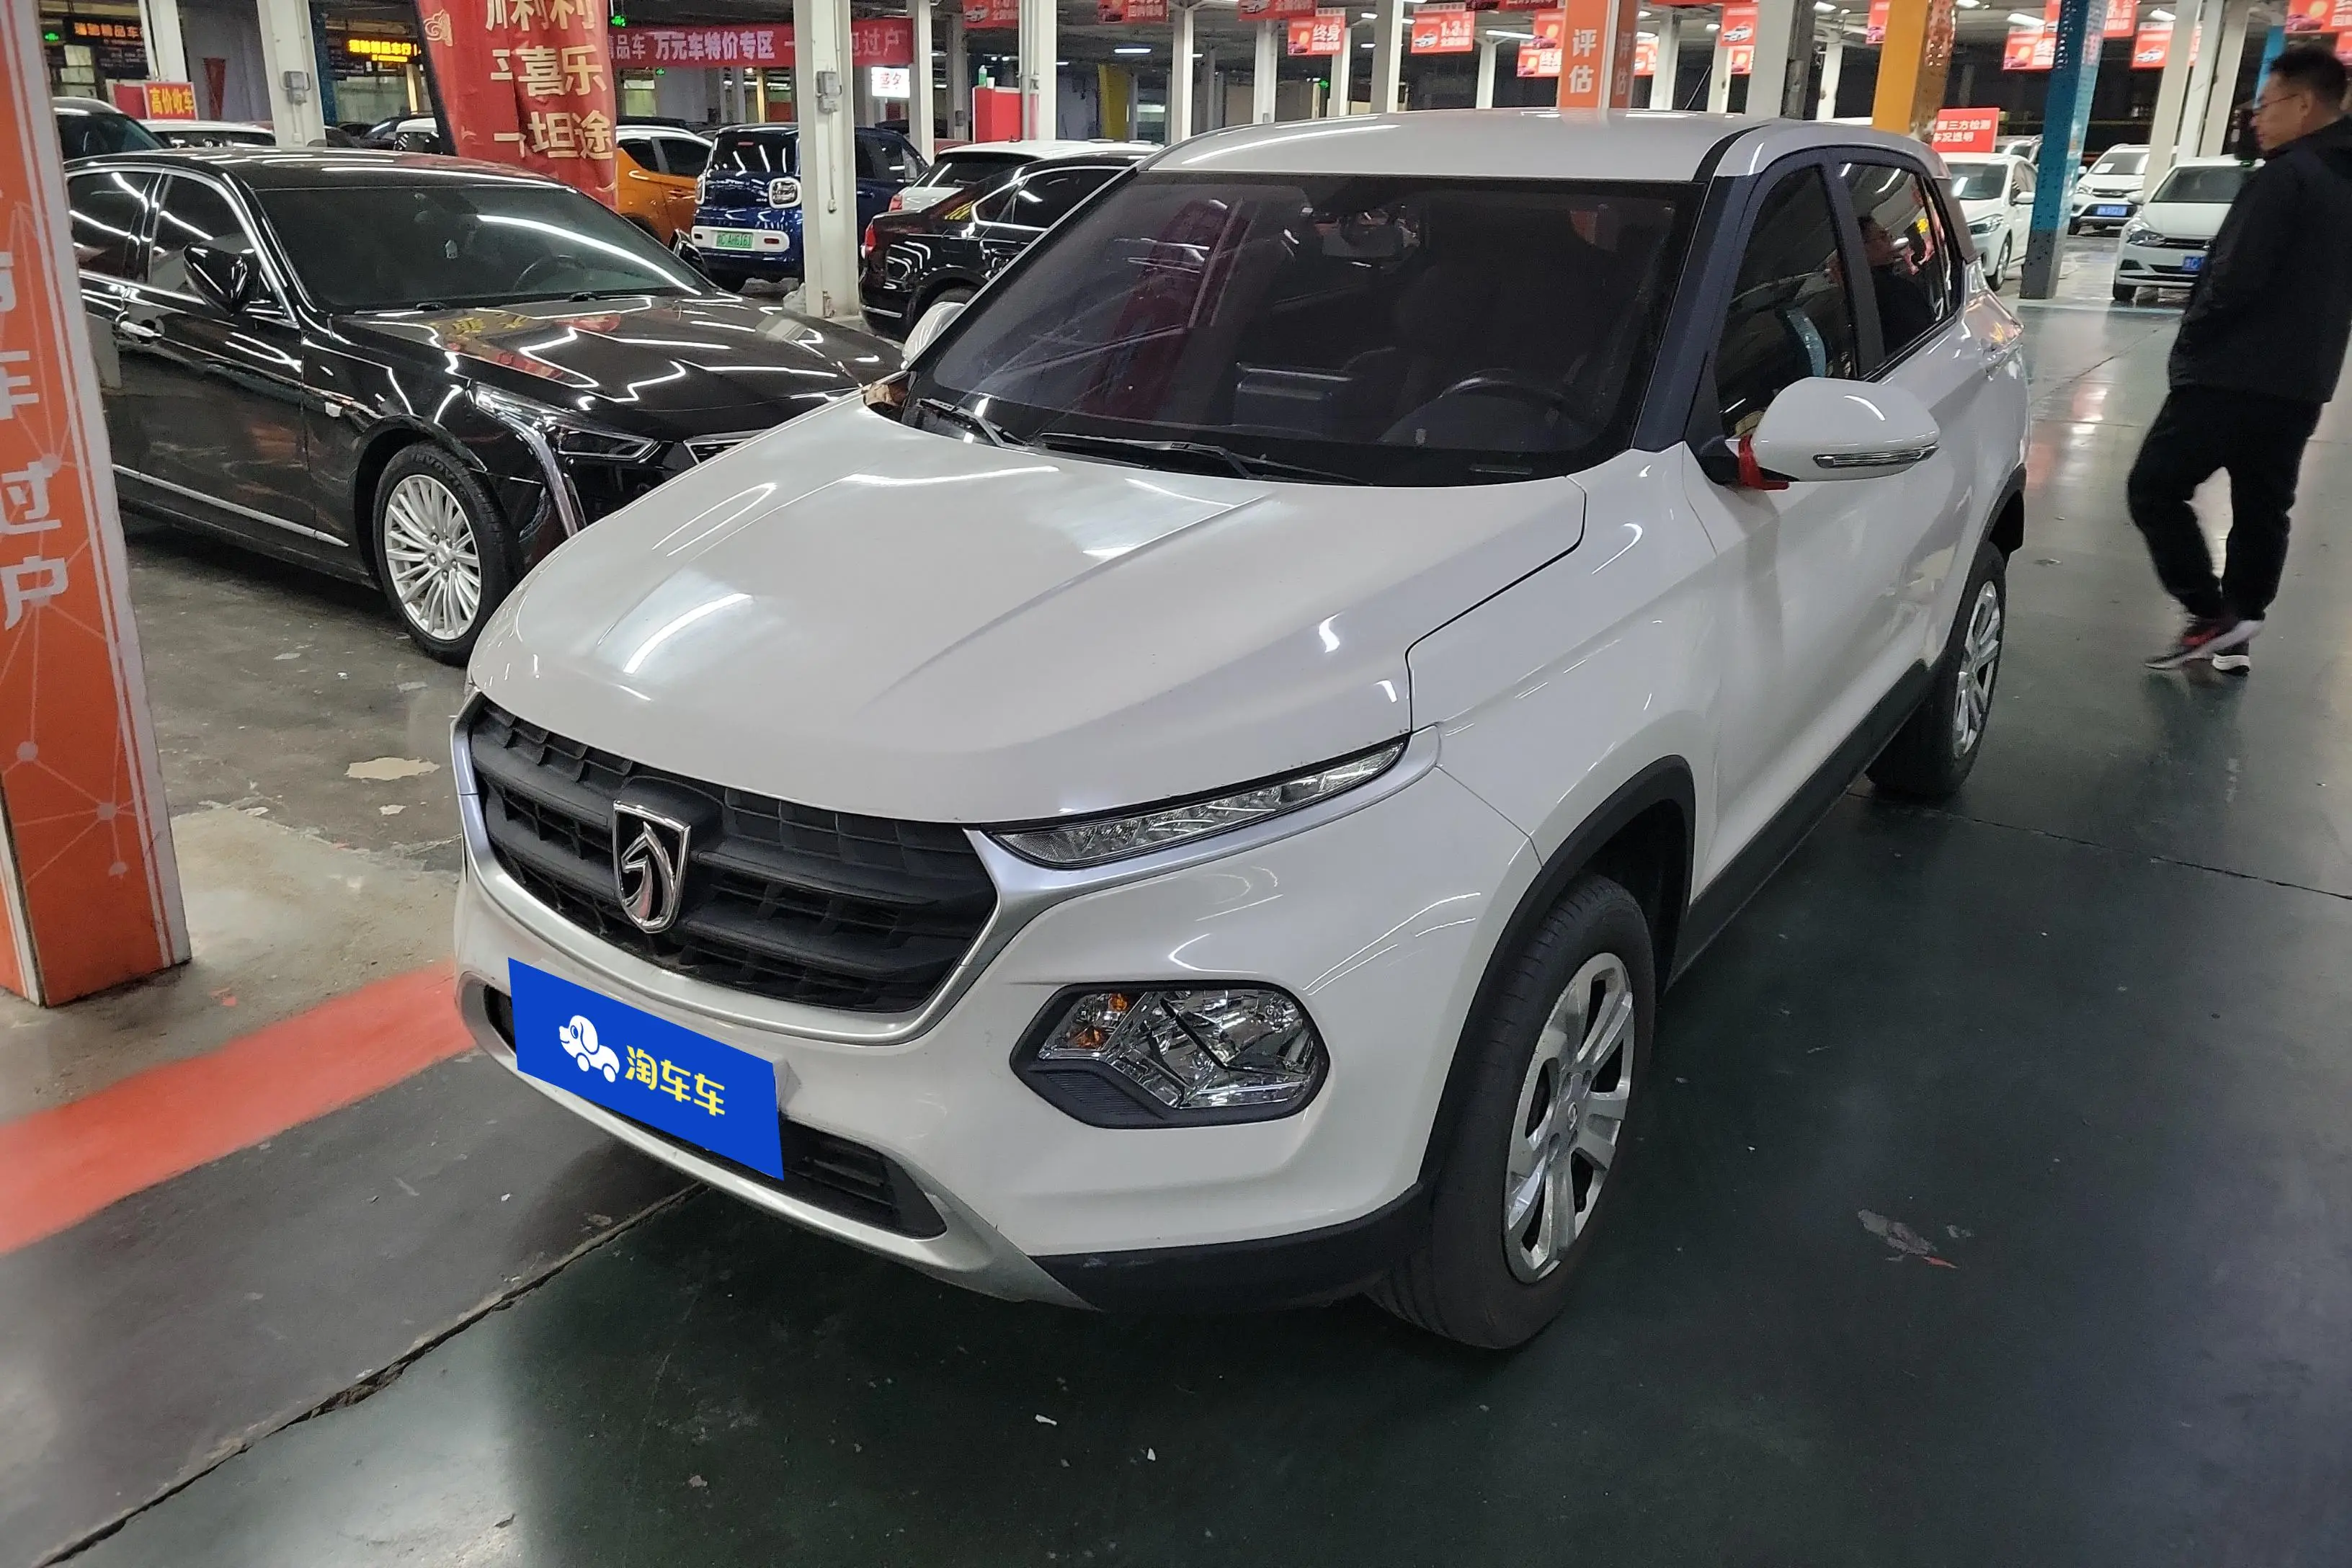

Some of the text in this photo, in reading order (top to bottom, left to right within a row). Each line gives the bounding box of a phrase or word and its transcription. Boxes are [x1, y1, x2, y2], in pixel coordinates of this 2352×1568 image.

[654, 30, 775, 61] 万元车特价专区
[1569, 28, 1598, 94] 评估
[149, 86, 195, 115] 高价收车
[1936, 120, 1992, 131] 第三方检测
